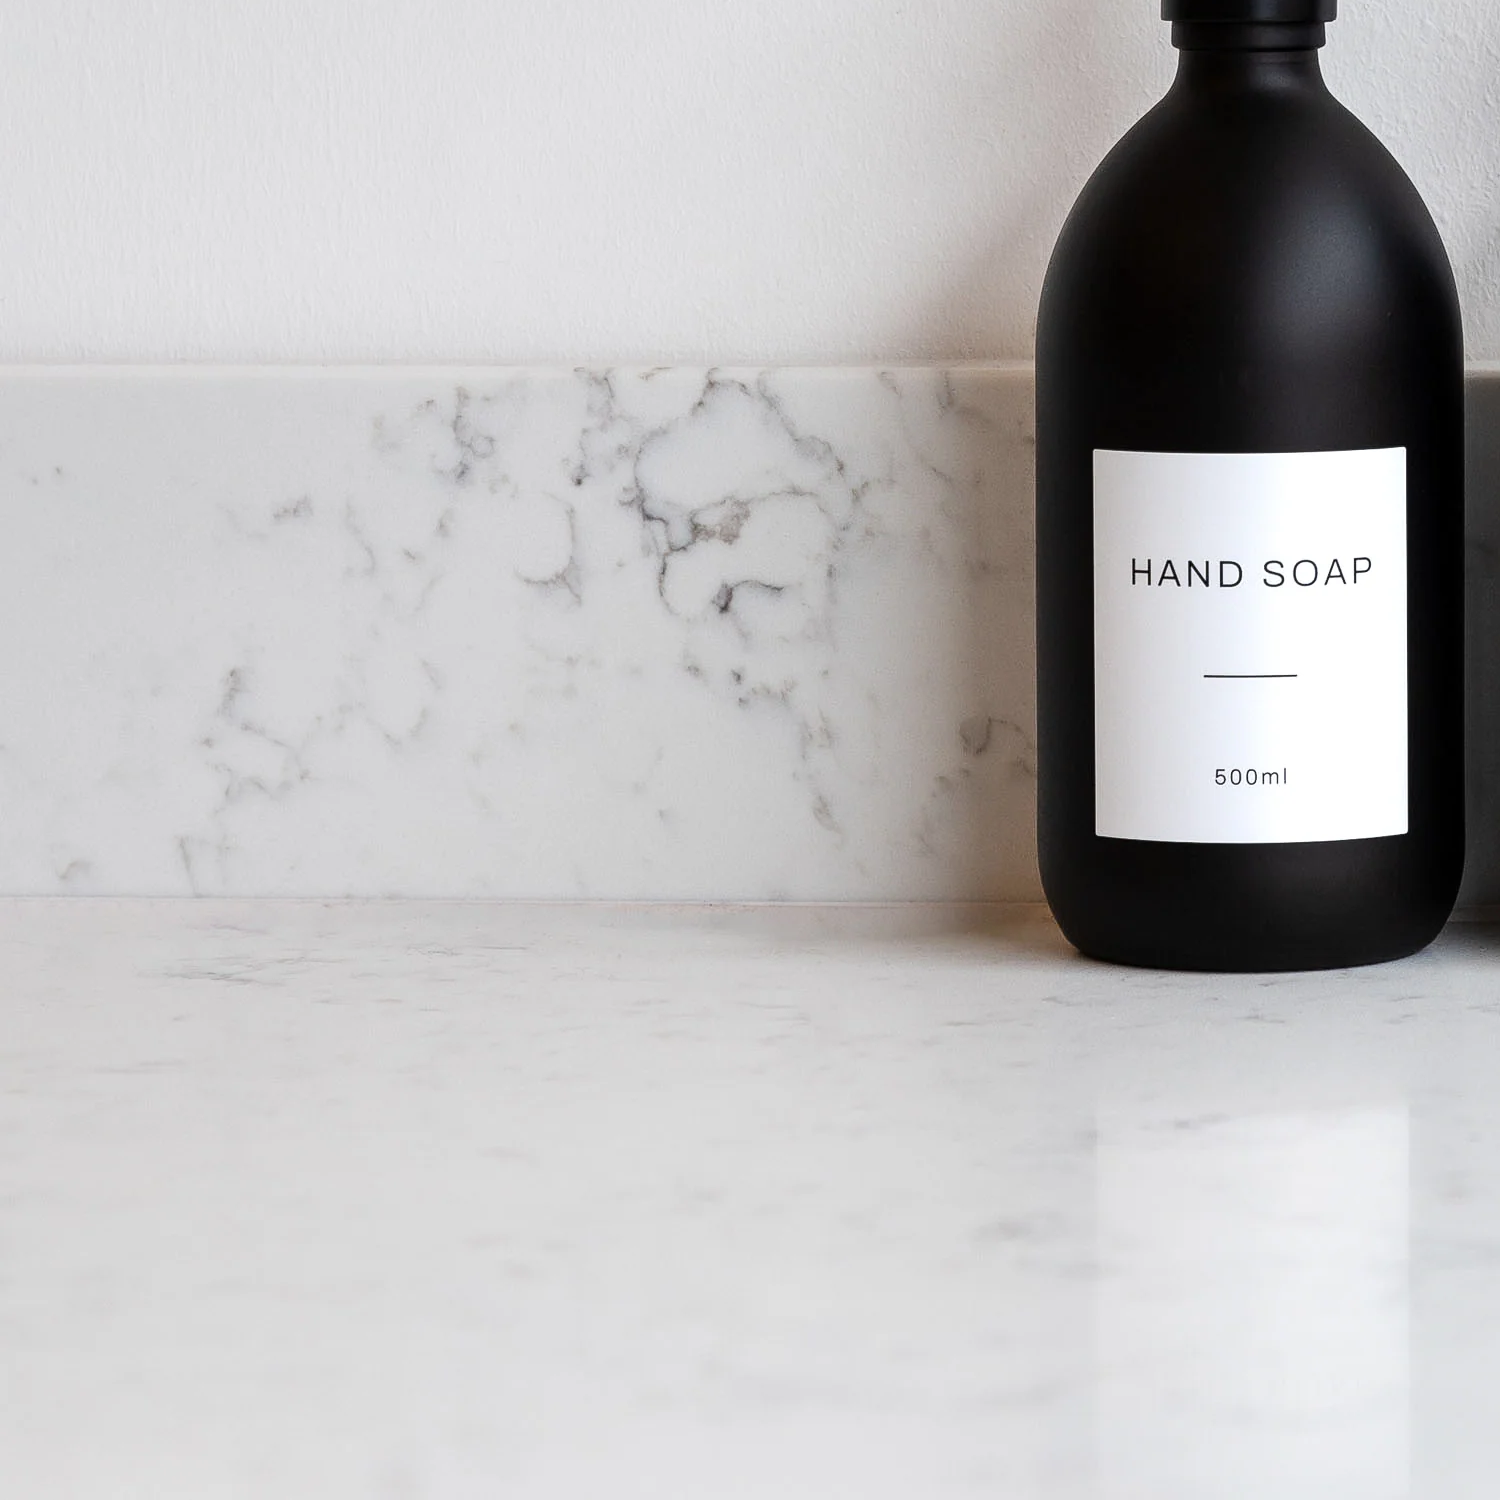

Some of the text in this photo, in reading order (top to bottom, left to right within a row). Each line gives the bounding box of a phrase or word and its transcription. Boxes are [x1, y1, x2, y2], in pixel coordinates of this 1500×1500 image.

[1131, 556, 1373, 588] HAND SOAP
[1214, 767, 1288, 786] 500ml
